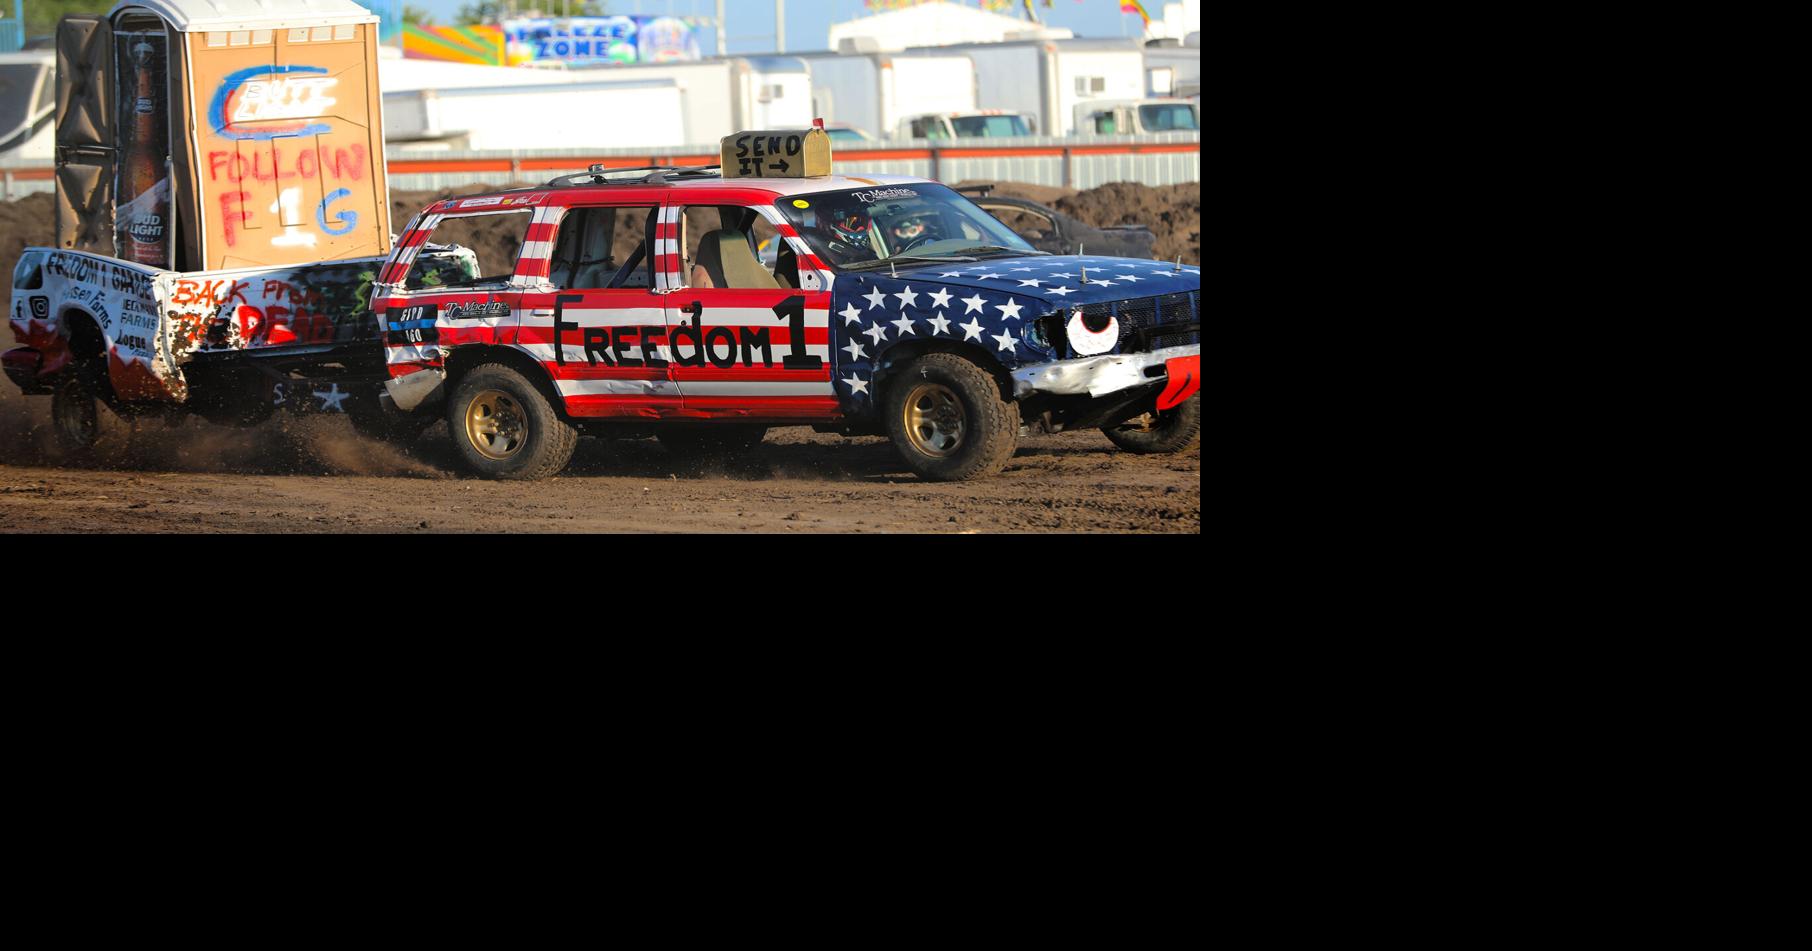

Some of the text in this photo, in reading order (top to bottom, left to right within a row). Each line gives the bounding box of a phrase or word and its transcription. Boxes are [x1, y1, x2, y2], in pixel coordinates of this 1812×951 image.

[535, 40, 609, 58] ZONE
[735, 134, 801, 158] SEND
[208, 143, 365, 183] FOLLOW
[738, 157, 764, 177] IT
[132, 214, 161, 225] UD
[129, 224, 164, 236] LIGHT
[172, 280, 250, 308] BACK
[120, 312, 158, 331] FARMS
[237, 304, 336, 346] DEAD
